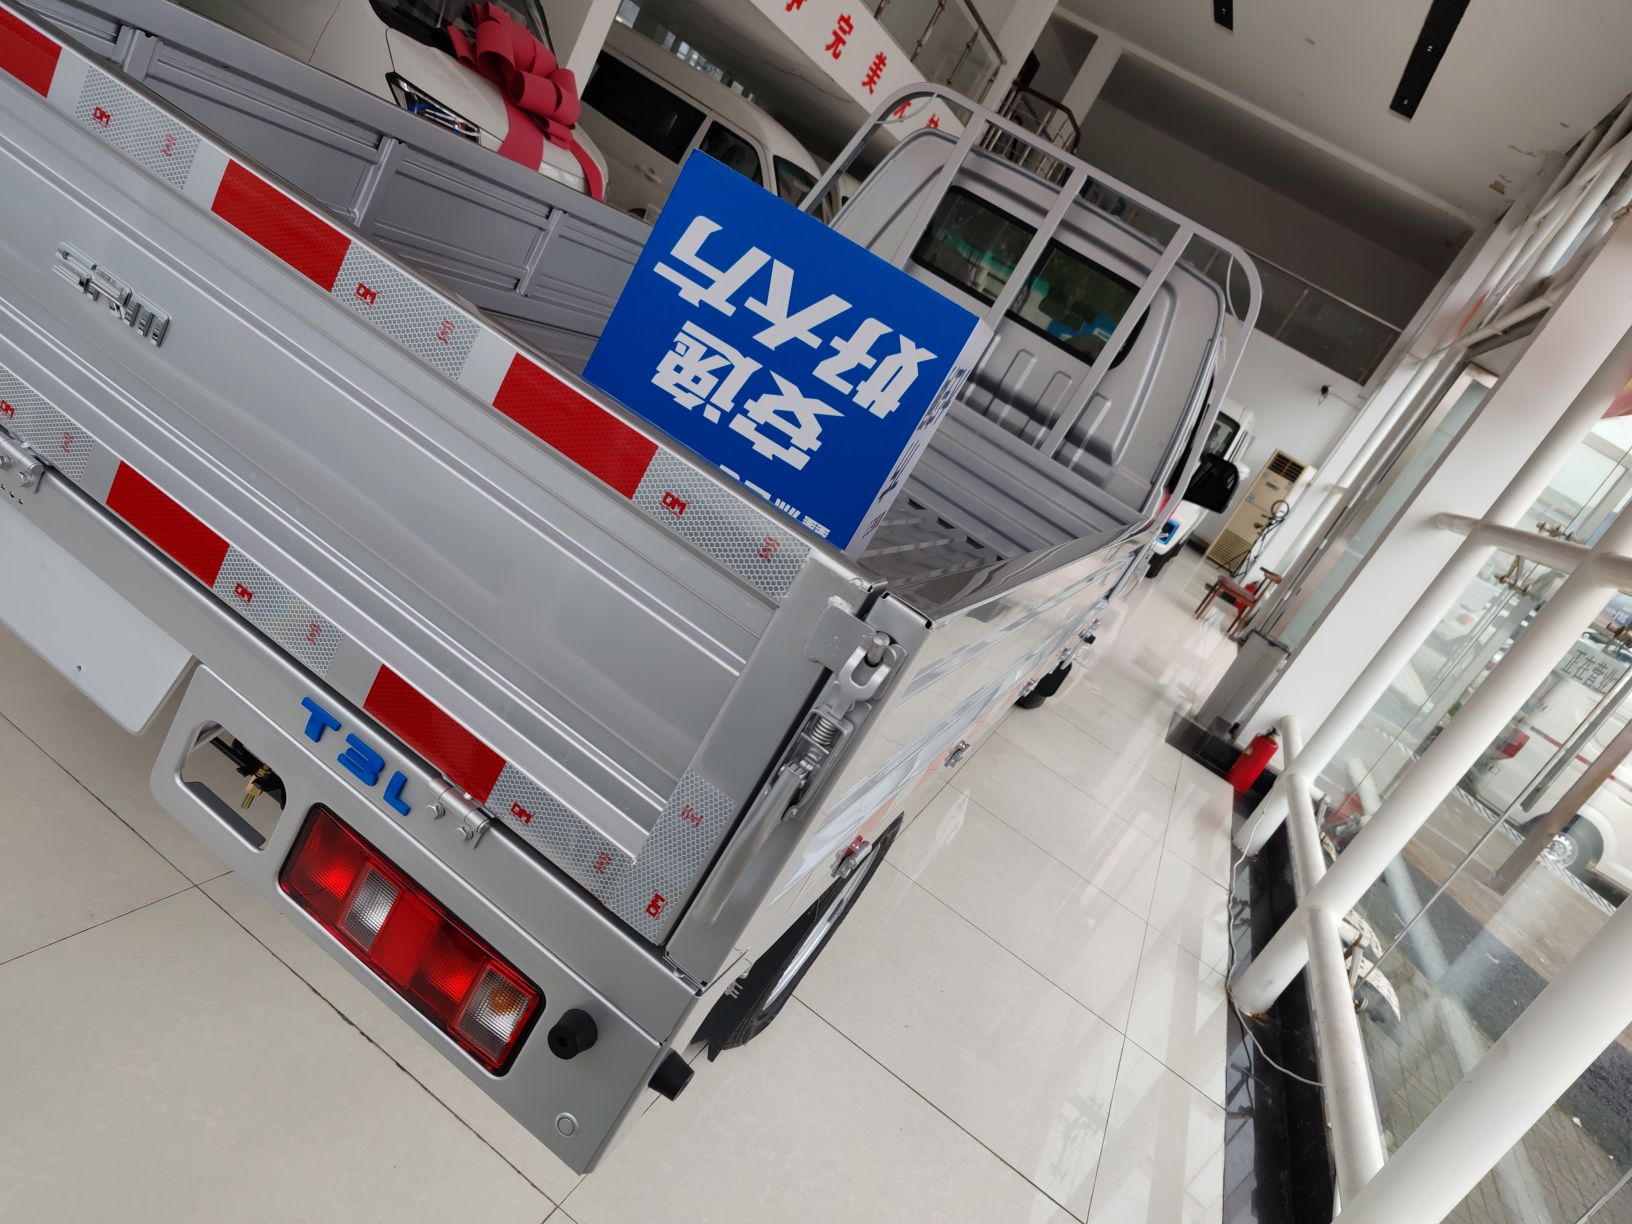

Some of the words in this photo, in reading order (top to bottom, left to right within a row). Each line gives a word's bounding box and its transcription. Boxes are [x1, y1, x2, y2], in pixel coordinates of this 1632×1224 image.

[653, 216, 938, 419] 好大方
[652, 320, 844, 470] 安逸
[301, 696, 412, 817] T3L
